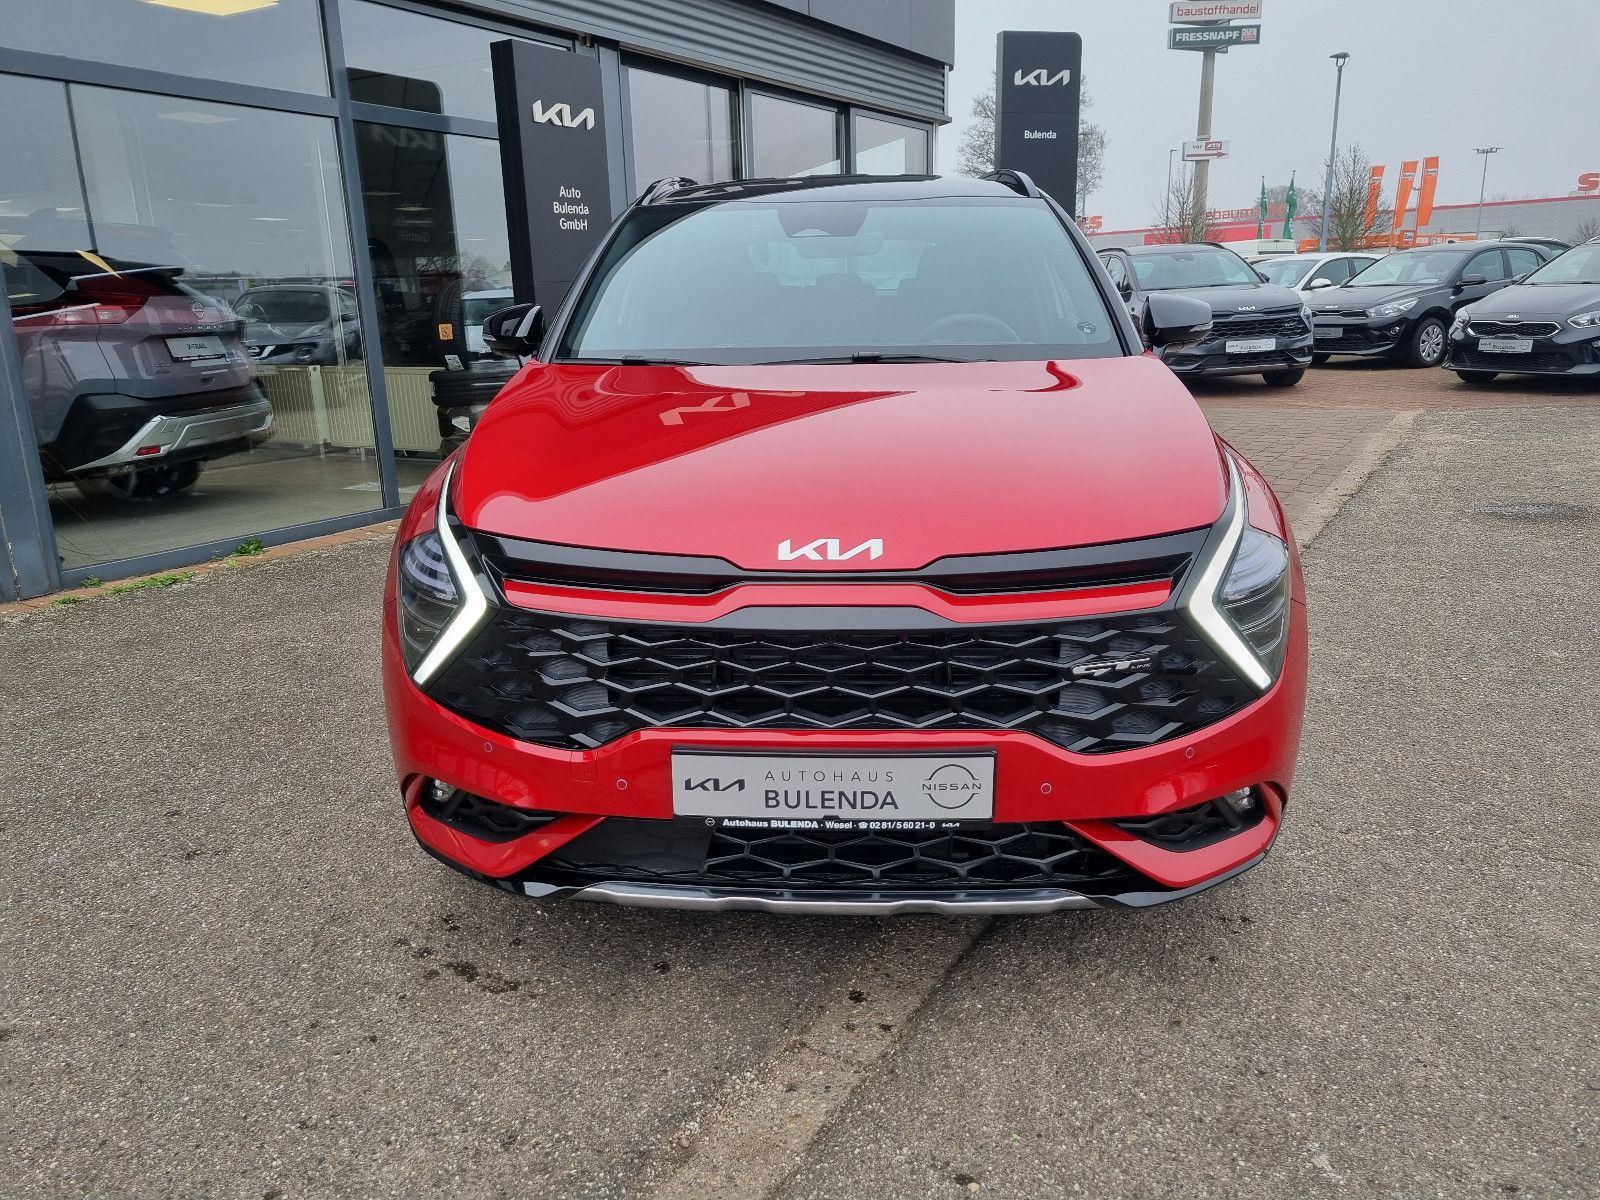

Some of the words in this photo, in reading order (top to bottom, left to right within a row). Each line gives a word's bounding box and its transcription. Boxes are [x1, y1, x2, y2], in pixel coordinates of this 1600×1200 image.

[1177, 4, 1259, 17] baustoffhandel
[1176, 31, 1240, 42] FRESSNAPF
[1024, 130, 1057, 139] Bulenda
[559, 186, 581, 198] Auto
[553, 202, 589, 215] Bulenda
[559, 218, 588, 231] GmbH
[778, 538, 884, 560] KIA
[764, 770, 895, 783] AUTOHAUS
[684, 777, 746, 793] KIA
[922, 782, 983, 791] NISSAN
[764, 790, 900, 810] BULENDA
[723, 818, 769, 828] Autohaus
[770, 820, 819, 829] BULENDA
[825, 820, 853, 829] Wesel
